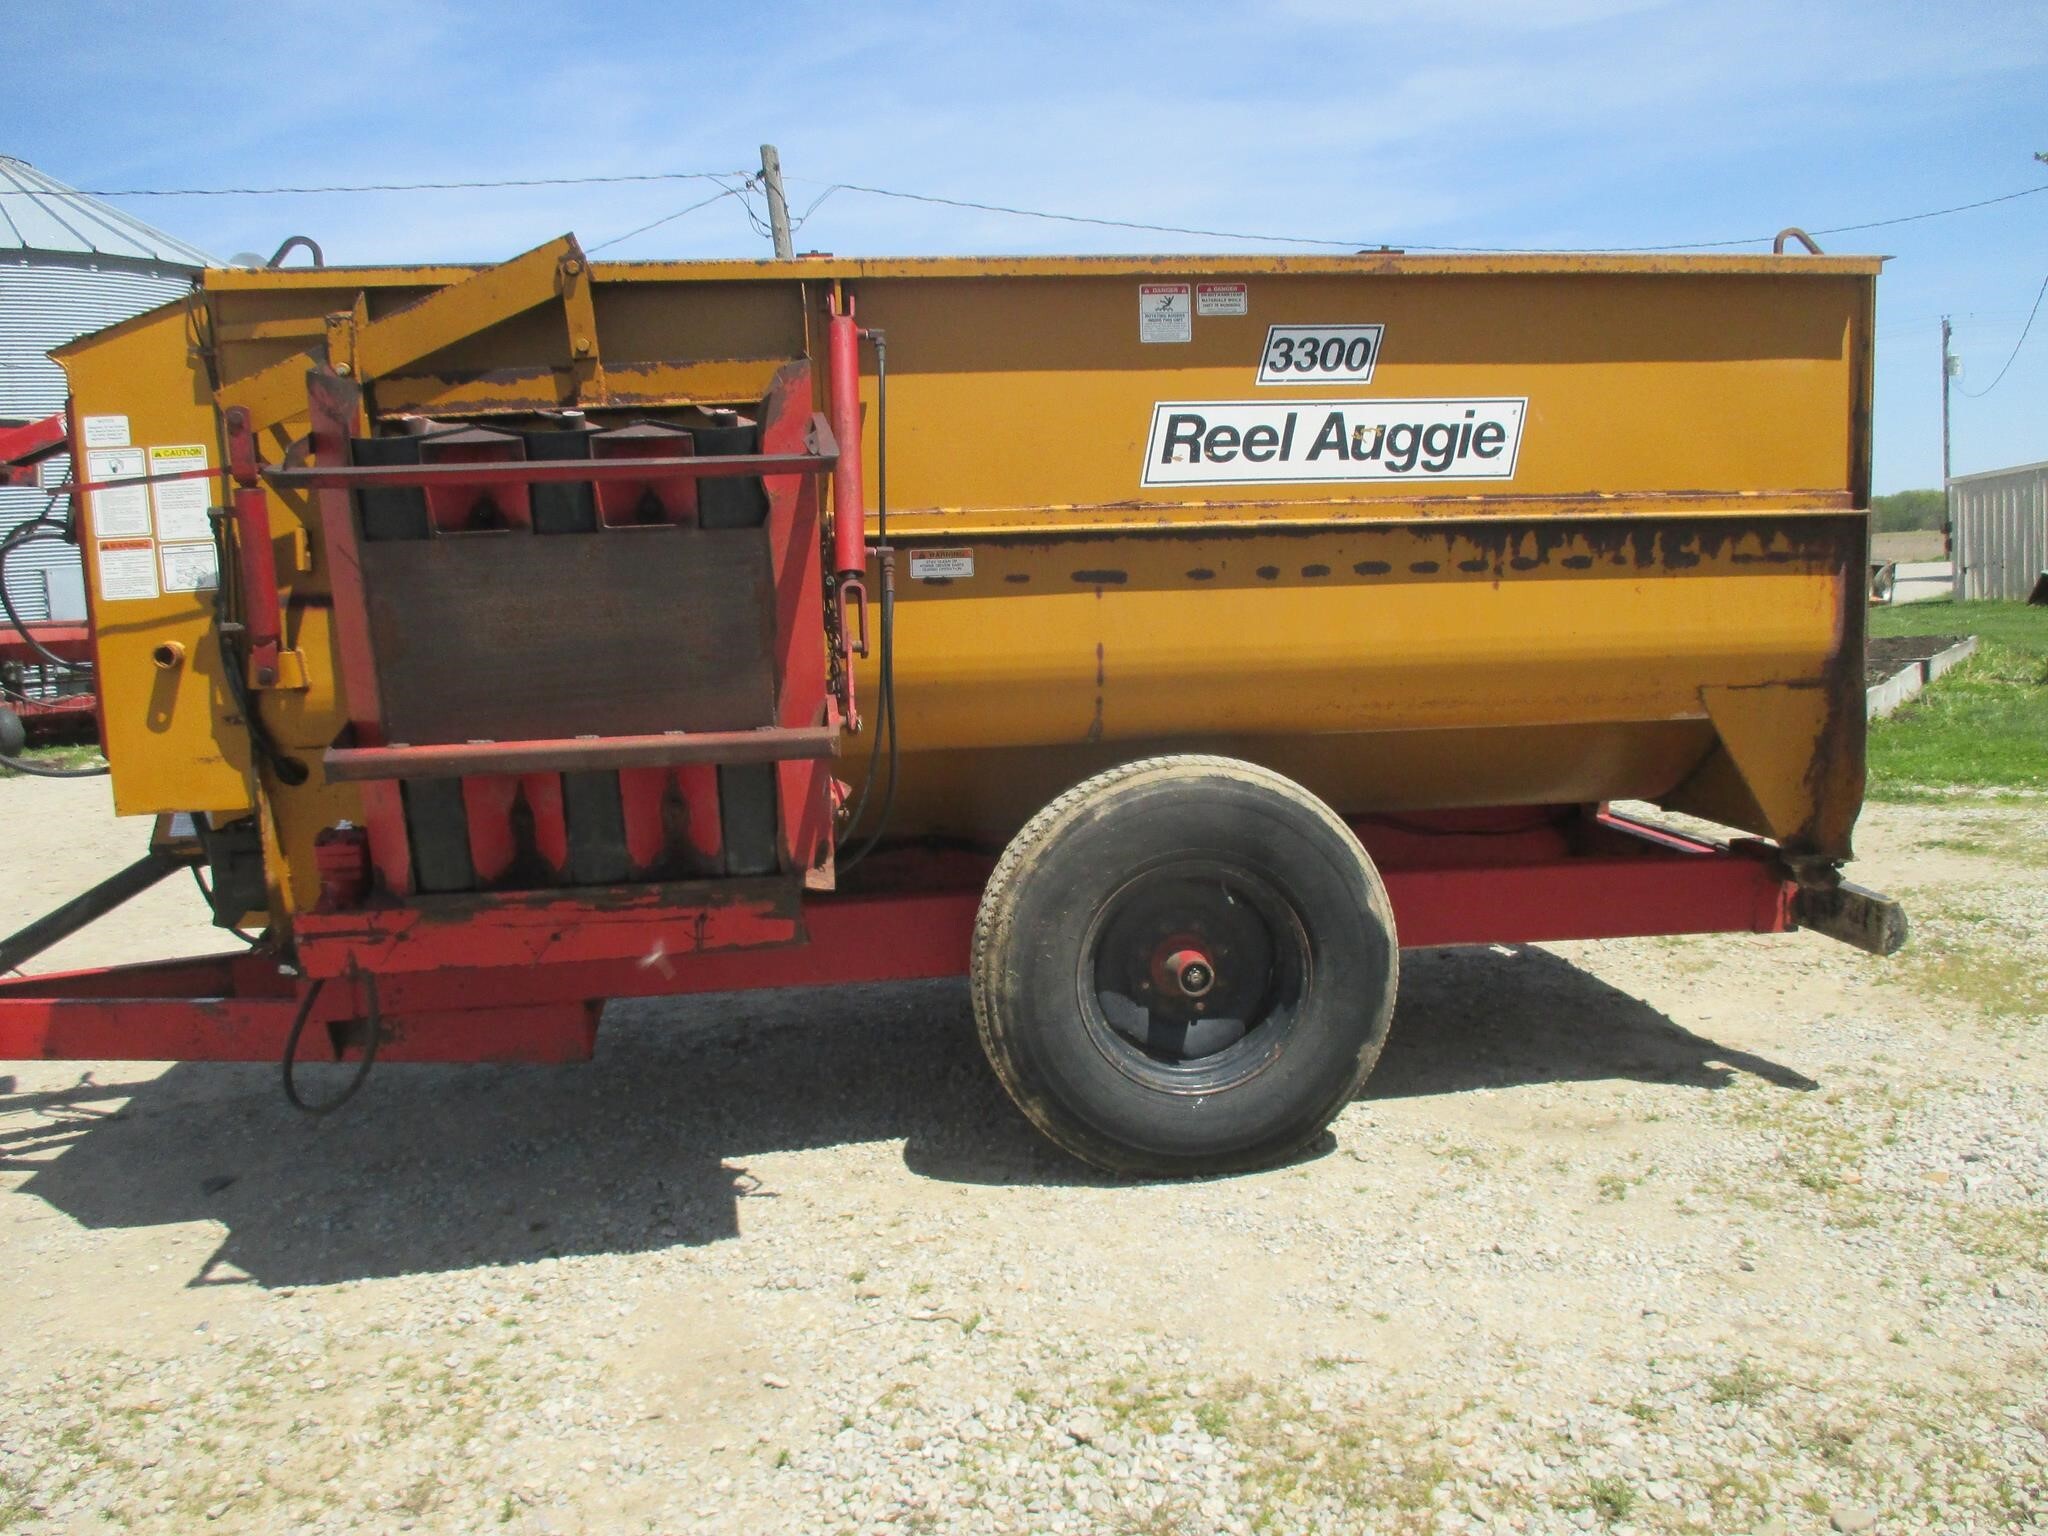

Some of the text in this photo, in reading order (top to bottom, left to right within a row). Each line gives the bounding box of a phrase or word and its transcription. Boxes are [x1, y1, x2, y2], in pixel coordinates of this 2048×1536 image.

[1268, 337, 1371, 373] 3300
[163, 448, 202, 457] CAUTION
[1160, 409, 1506, 473] Reel Auggie
